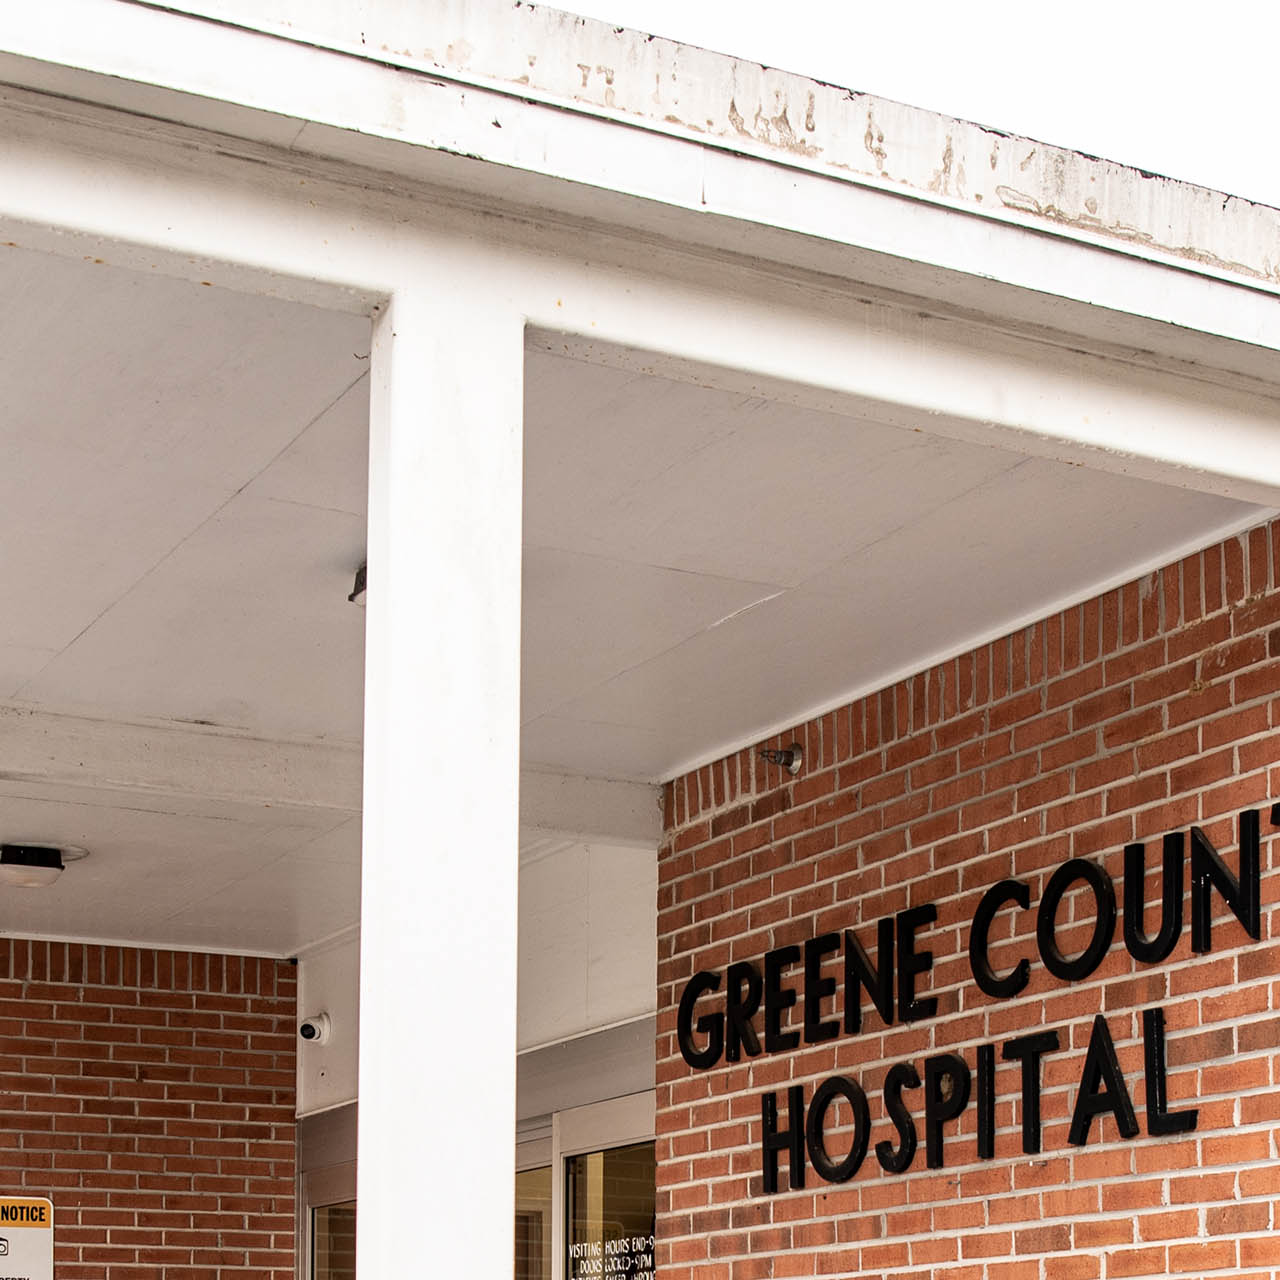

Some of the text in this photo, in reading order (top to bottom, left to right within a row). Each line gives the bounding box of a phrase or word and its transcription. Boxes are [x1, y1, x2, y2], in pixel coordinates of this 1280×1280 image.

[677, 903, 939, 1070] GREENE
[761, 1008, 1199, 1193] HOSPITAL
[0, 1205, 46, 1222] NOTICE
[569, 1241, 601, 1259] VISITING
[605, 1238, 630, 1255] HOURS
[580, 1258, 602, 1274] DOORS
